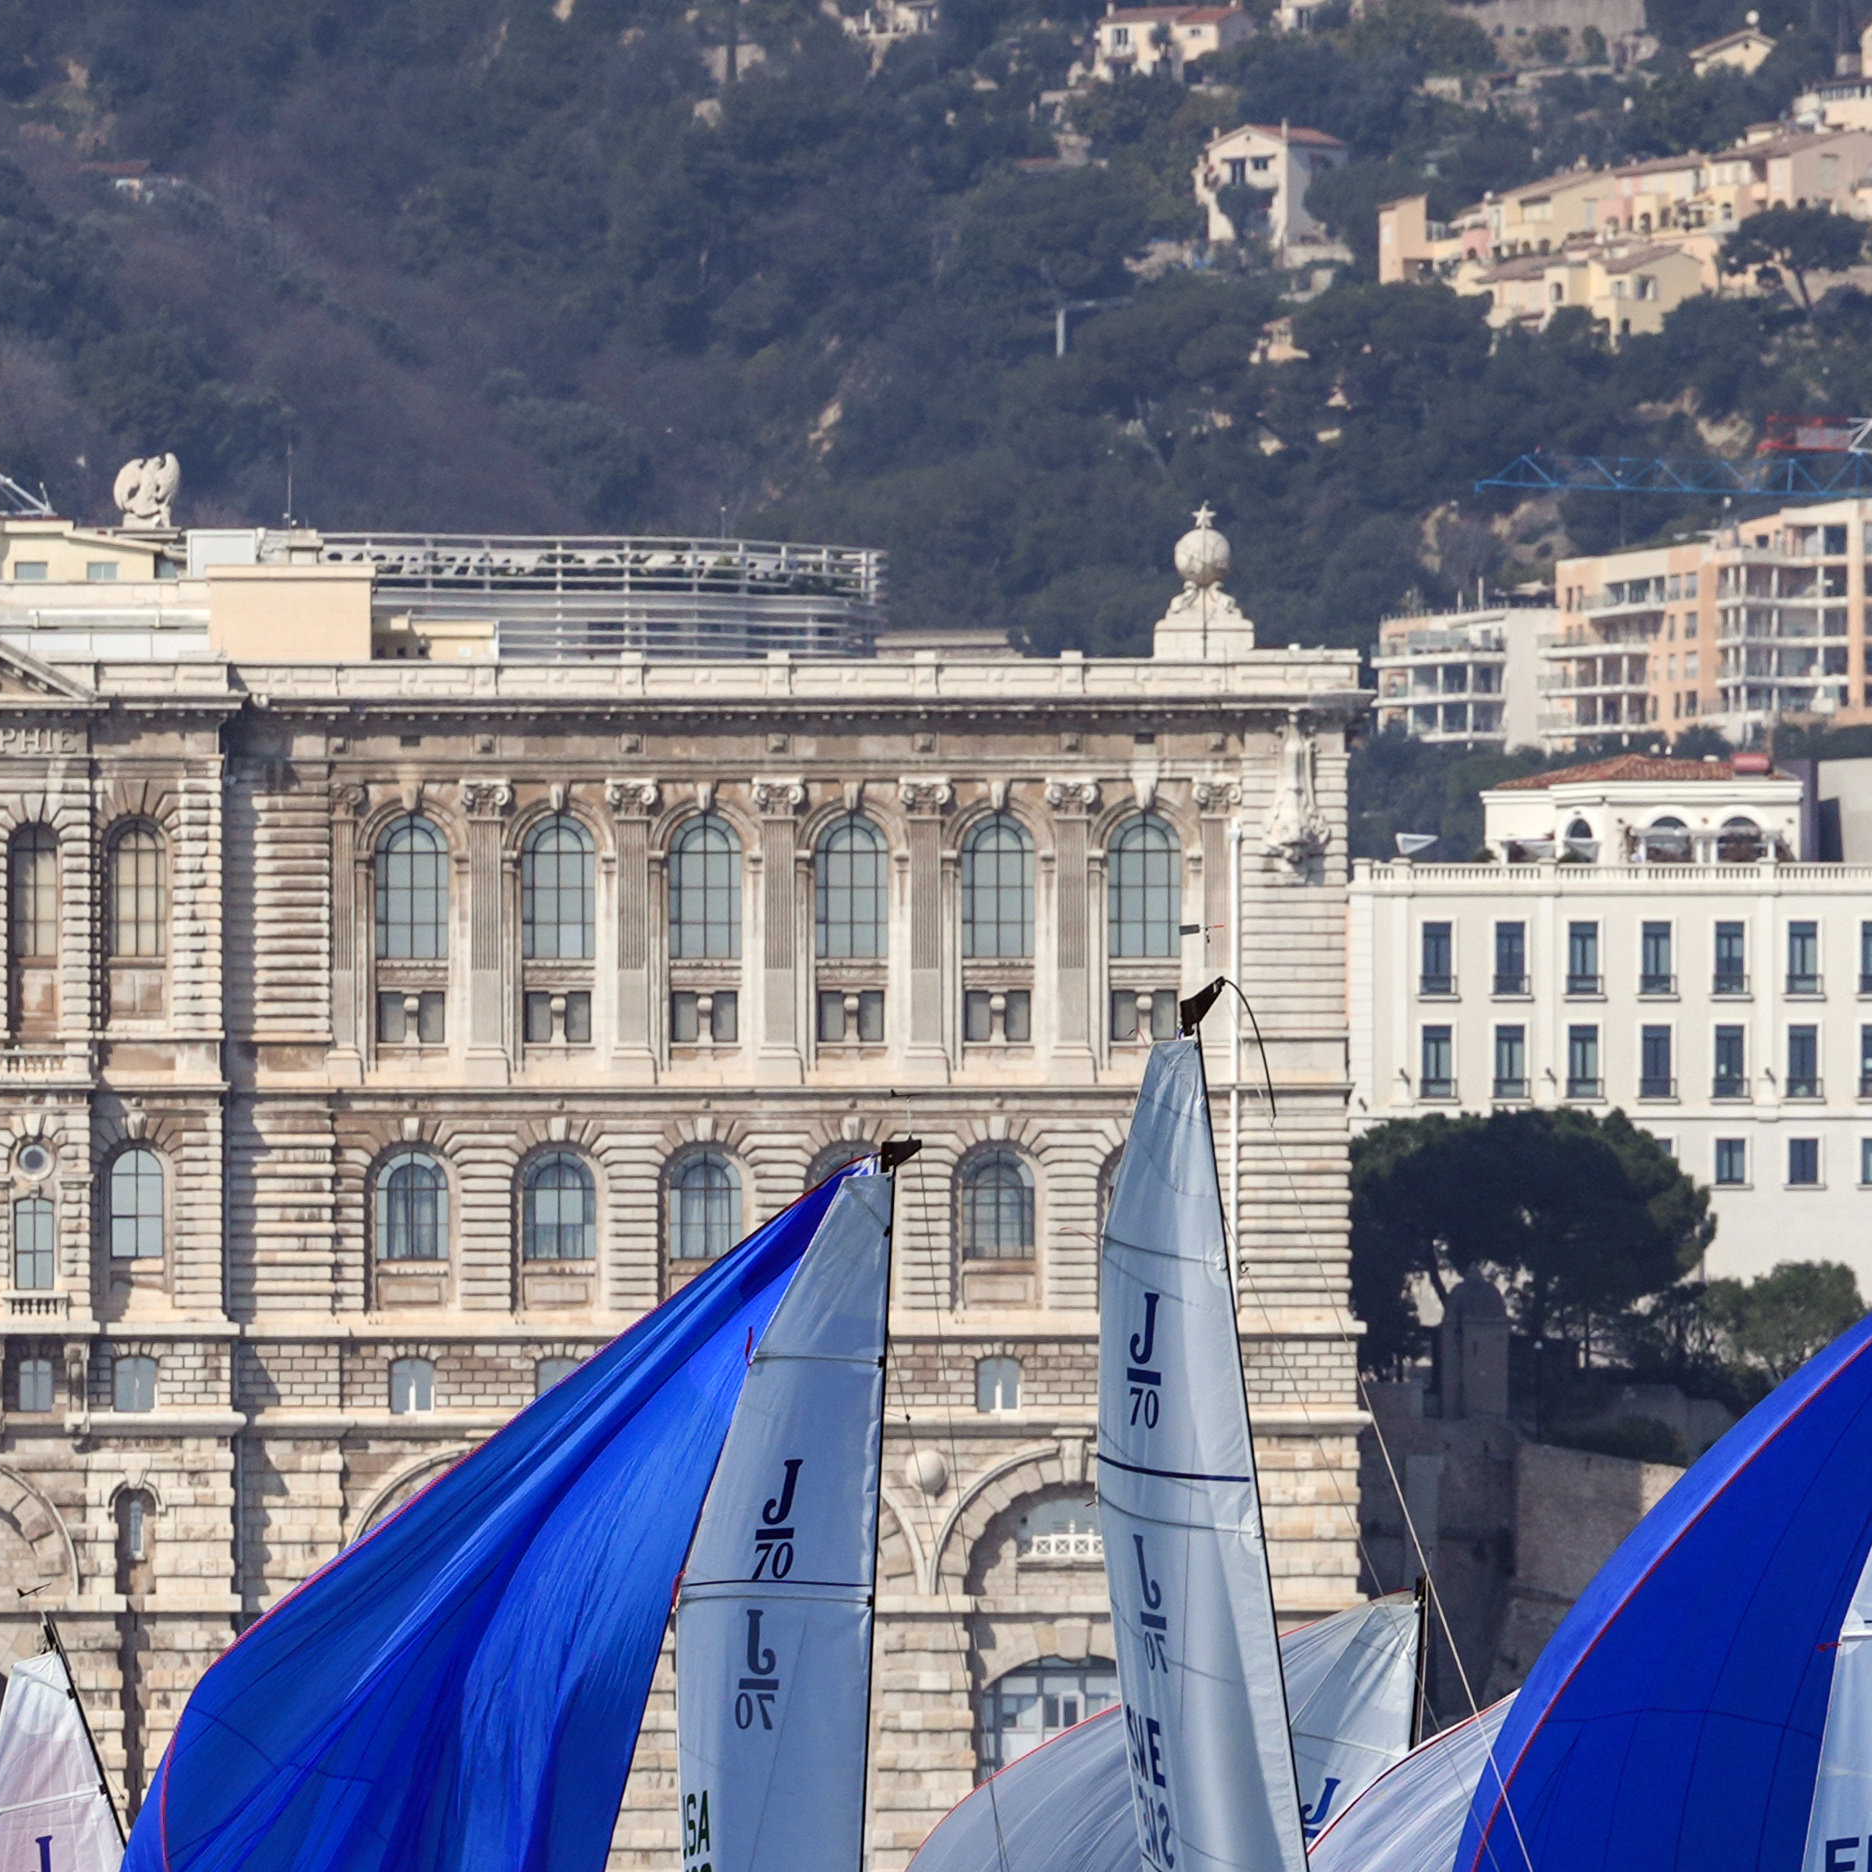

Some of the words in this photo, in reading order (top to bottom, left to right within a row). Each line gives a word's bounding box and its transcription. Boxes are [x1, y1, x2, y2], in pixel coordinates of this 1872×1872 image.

[1130, 1292, 1159, 1366] J
[1128, 1386, 1159, 1431] 70
[762, 1459, 802, 1525] J
[753, 1542, 794, 1581] 70
